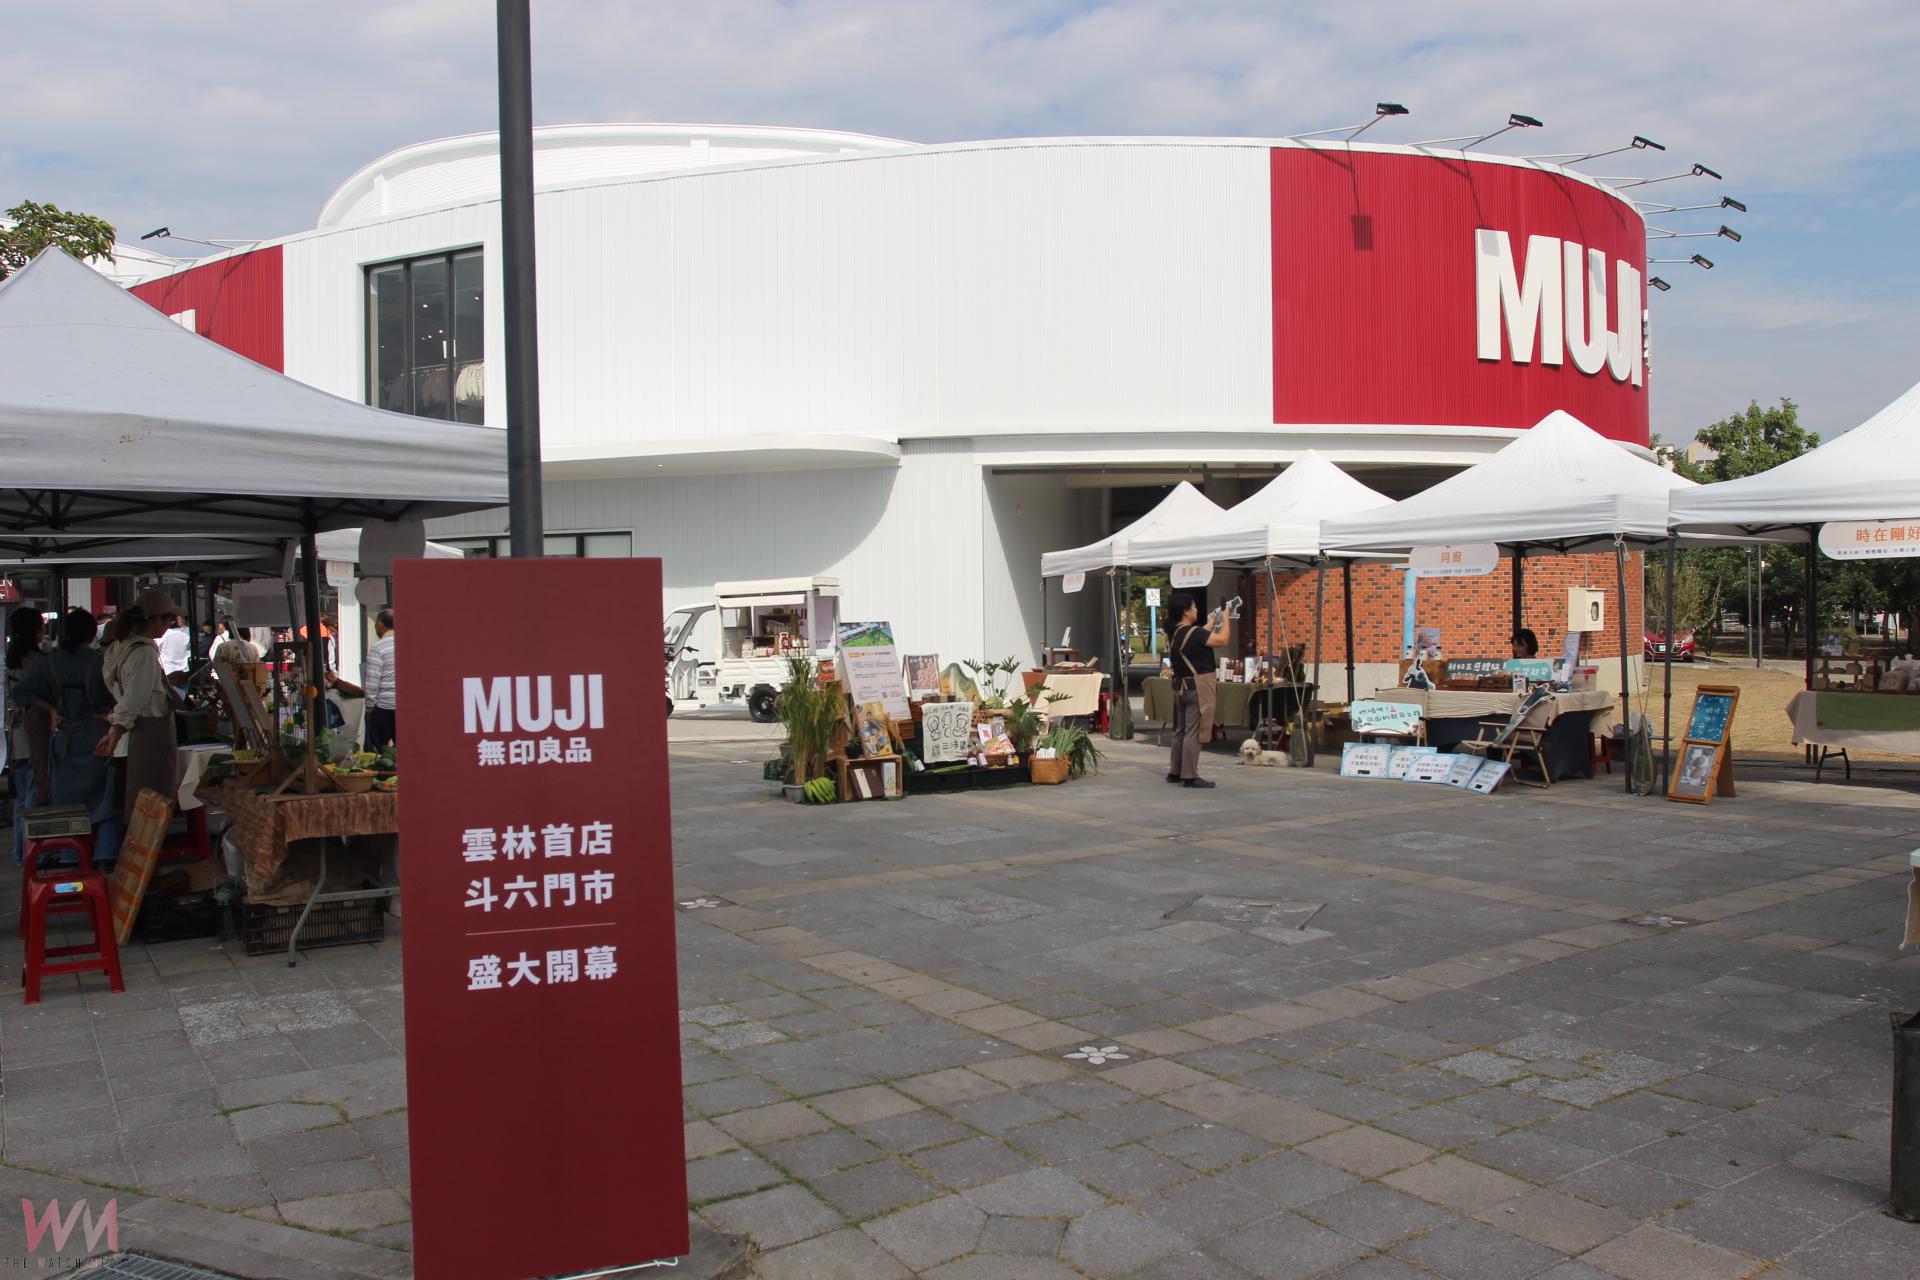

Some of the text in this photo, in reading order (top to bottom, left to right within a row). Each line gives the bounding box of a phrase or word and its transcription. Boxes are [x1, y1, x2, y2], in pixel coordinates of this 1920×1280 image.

[1475, 228, 1642, 388] MUJI
[463, 674, 604, 734] MUJI
[477, 737, 592, 766] 無印良品
[462, 821, 613, 862] 雲林首店
[464, 870, 615, 912] 斗六門市
[467, 946, 618, 991] 盛大開幕
